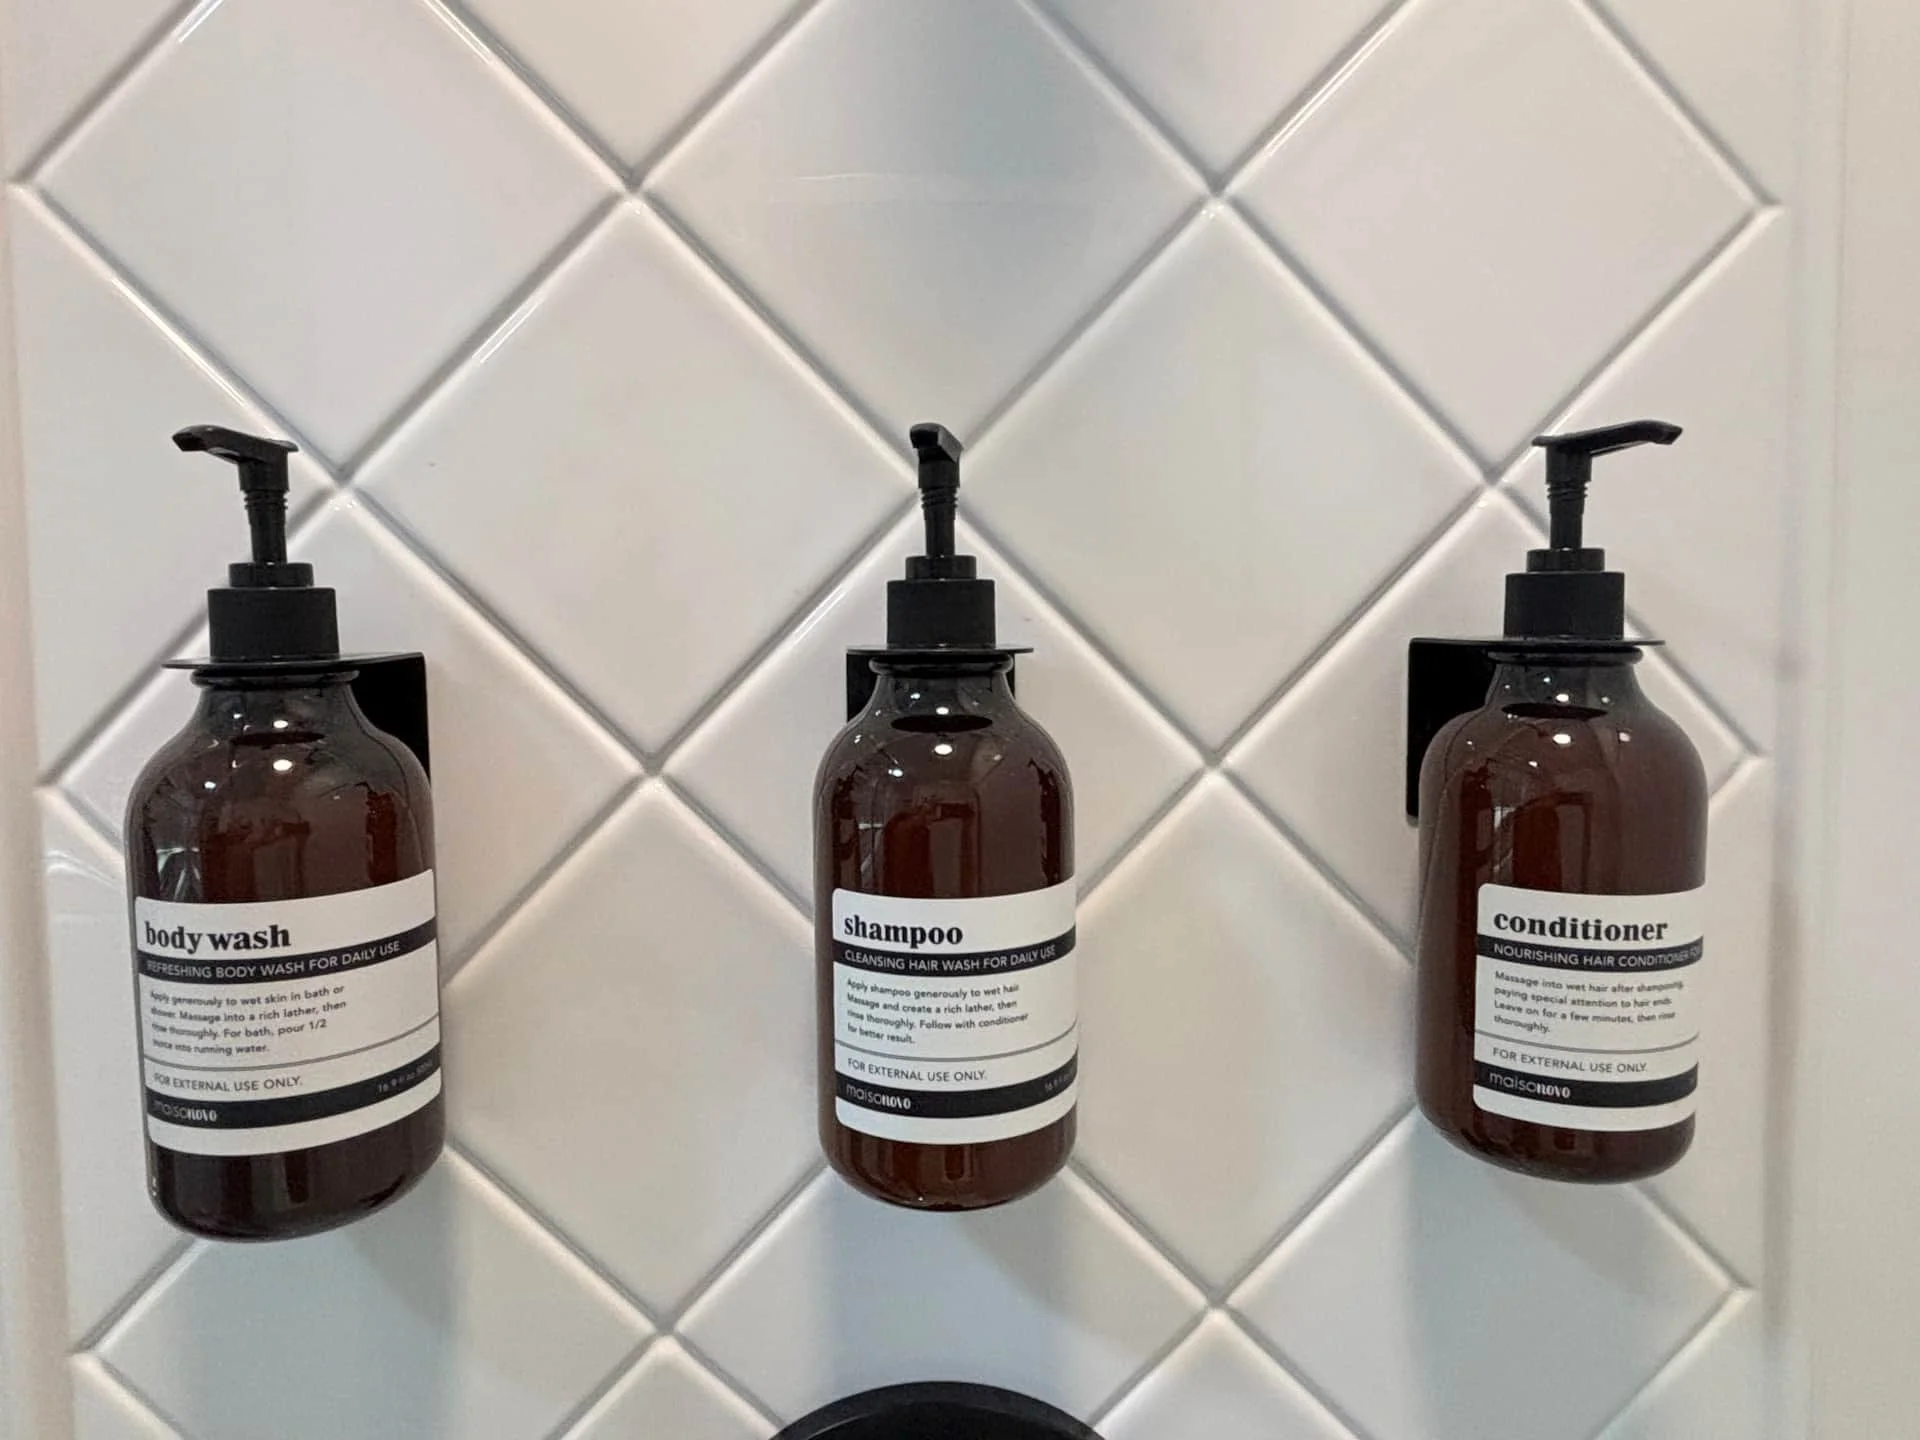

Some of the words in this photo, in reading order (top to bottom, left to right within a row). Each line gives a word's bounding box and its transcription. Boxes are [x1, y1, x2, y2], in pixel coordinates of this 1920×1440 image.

[145, 921, 202, 954] body
[207, 924, 291, 950] wash
[844, 914, 964, 949] shampoo
[1493, 912, 1668, 941] conditioner
[147, 959, 212, 979] REFRESHING
[215, 965, 256, 978] BODY
[260, 961, 304, 976] WASH
[309, 956, 338, 971] FOR
[342, 948, 377, 966] DAILY
[379, 941, 400, 956] USE
[845, 949, 905, 970] CLEANSING
[908, 959, 938, 971] HAIR
[942, 958, 980, 971] WASH
[983, 956, 1008, 969] FOR
[1010, 948, 1039, 966] DAILY
[1040, 944, 1056, 959] USE
[1494, 943, 1579, 965] NOURISHING
[1583, 955, 1615, 968] HAIR
[847, 978, 868, 993] Apply
[870, 984, 911, 998] shampoo
[914, 988, 967, 1000] generously
[970, 988, 981, 997] to
[984, 986, 1001, 996] wet
[1495, 970, 1538, 987] Massage
[1542, 978, 1563, 989] into
[1566, 983, 1586, 992] wet
[1588, 983, 1609, 993] hair
[1611, 983, 1633, 993] after
[226, 997, 237, 1006] to
[240, 996, 261, 1005] wet
[265, 993, 287, 1004] skin
[291, 991, 301, 1001] in
[304, 986, 329, 999] bath
[333, 986, 344, 995] or
[847, 992, 880, 1010] Massage
[883, 1002, 899, 1011] and
[903, 1005, 932, 1013] create
[944, 1003, 962, 1014] rich
[965, 1003, 995, 1013] lather,
[997, 1000, 1017, 1010] then
[1494, 986, 1528, 1001] paying
[1531, 994, 1567, 1005] special
[1571, 998, 1618, 1008] attention
[1621, 1000, 1631, 1008] to
[224, 1012, 245, 1021] into
[249, 1013, 255, 1021] a
[259, 1009, 280, 1020] rich
[283, 1006, 319, 1018] lather,
[322, 1001, 346, 1013] then
[920, 1018, 952, 1029] Follow
[955, 1018, 975, 1029] with
[978, 1013, 1029, 1028] conditioner
[1494, 1000, 1523, 1013] Leave
[1525, 1007, 1539, 1016] on
[1542, 1008, 1557, 1018] for
[1570, 1011, 1589, 1021] few
[224, 1028, 241, 1038] For
[278, 1023, 305, 1037] pour
[309, 1018, 327, 1030] 1/2
[859, 1026, 884, 1040] better
[1494, 1015, 1550, 1034] thoroughly.
[848, 1058, 866, 1073] FOR
[868, 1064, 923, 1081] EXTERNAL
[928, 1071, 949, 1082] USE
[954, 1070, 987, 1081] ONLY.
[1493, 1047, 1517, 1062] FOR
[1521, 1054, 1585, 1072] EXTERNAL
[1589, 1062, 1612, 1073] USE
[153, 1072, 170, 1086] FOR
[173, 1077, 230, 1092] EXTERNAL
[234, 1079, 259, 1092] USE
[263, 1077, 303, 1091] ONLY.
